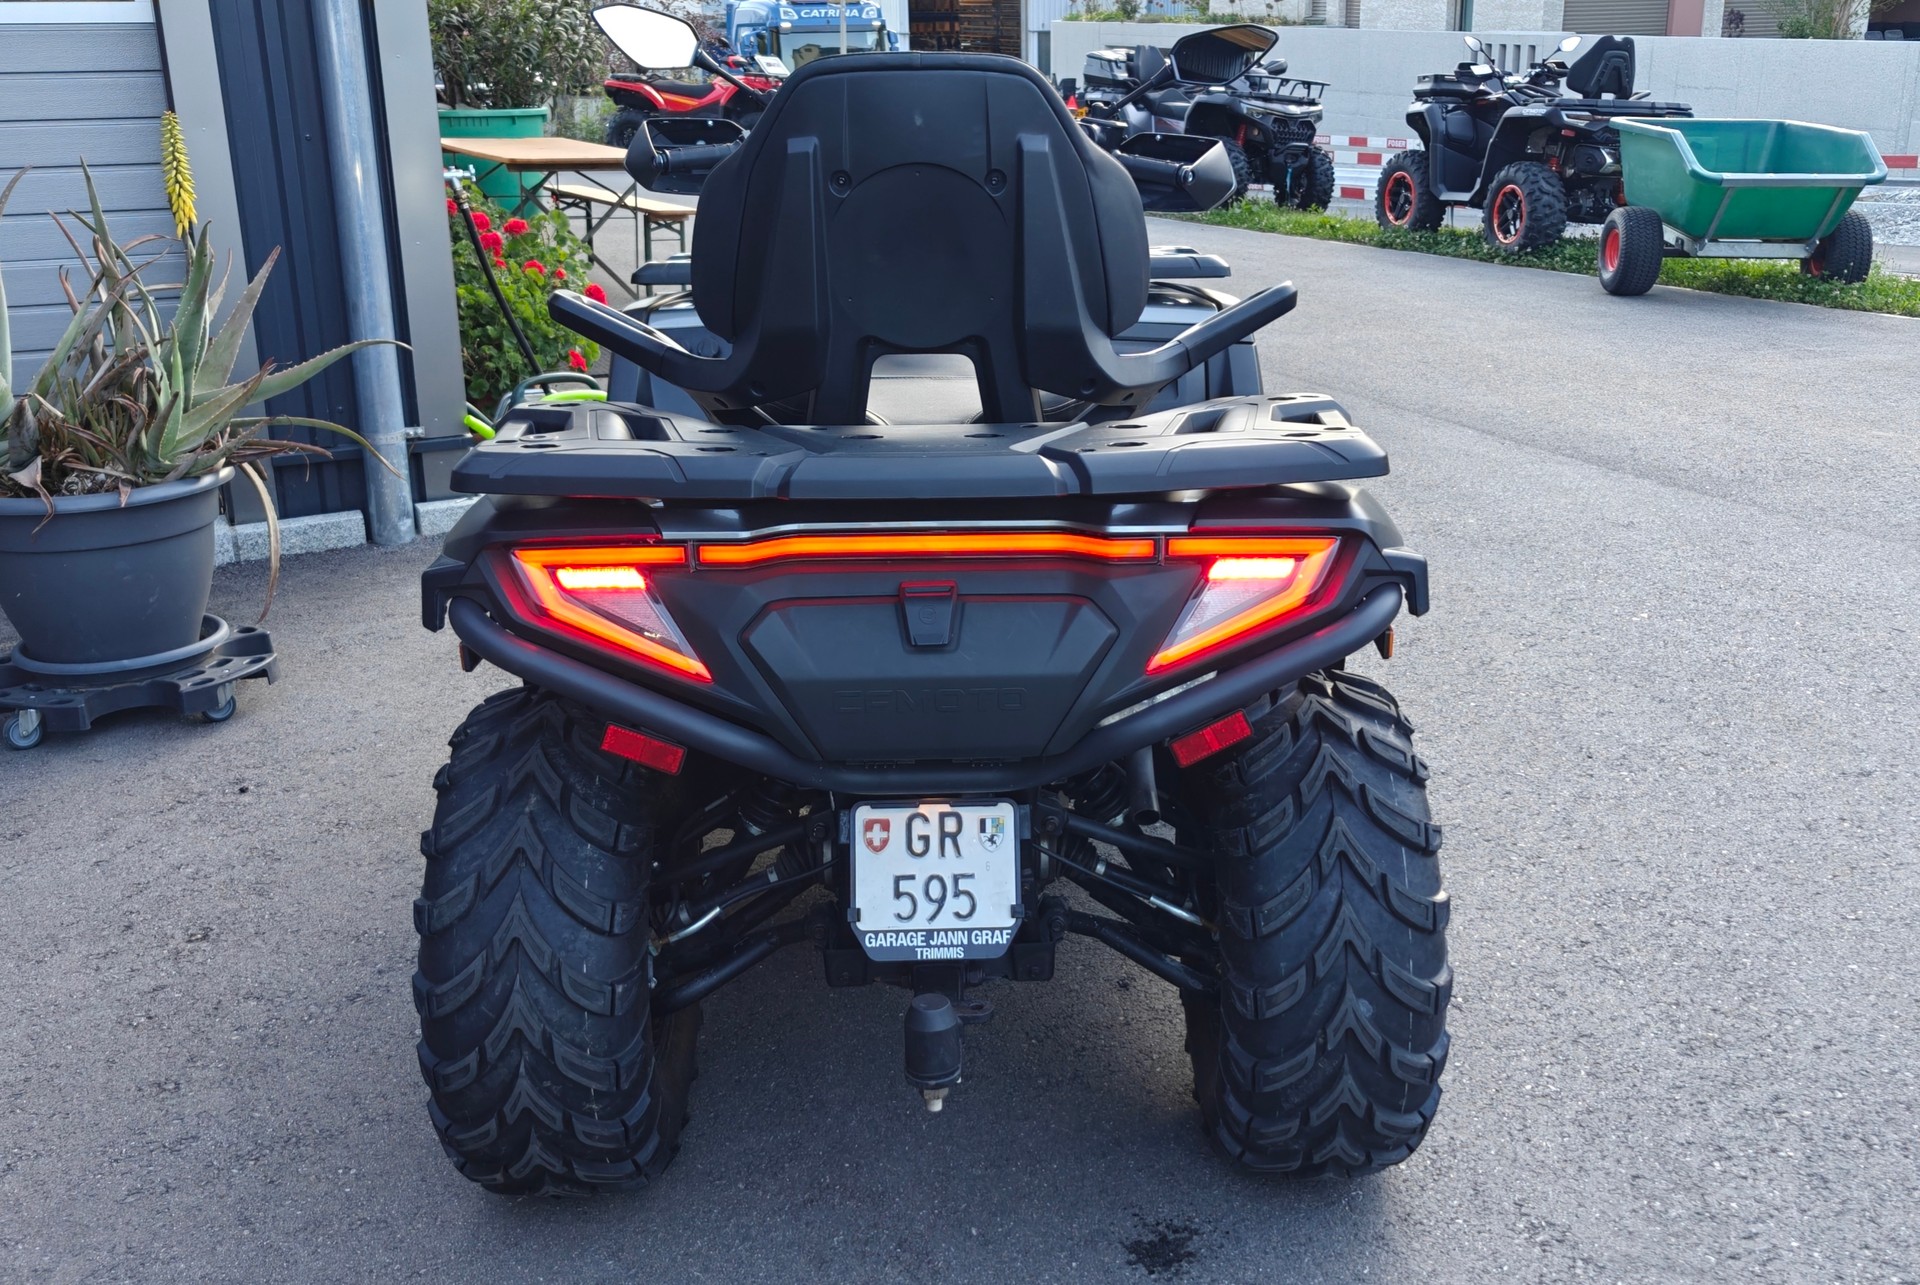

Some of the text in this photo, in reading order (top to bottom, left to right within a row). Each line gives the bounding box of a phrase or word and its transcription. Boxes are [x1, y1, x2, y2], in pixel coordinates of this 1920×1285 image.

[905, 811, 964, 859] GR
[893, 873, 977, 925] 595
[865, 930, 1012, 948] GARAGE JANN GRAF
[915, 947, 964, 959] TRIMMIS
